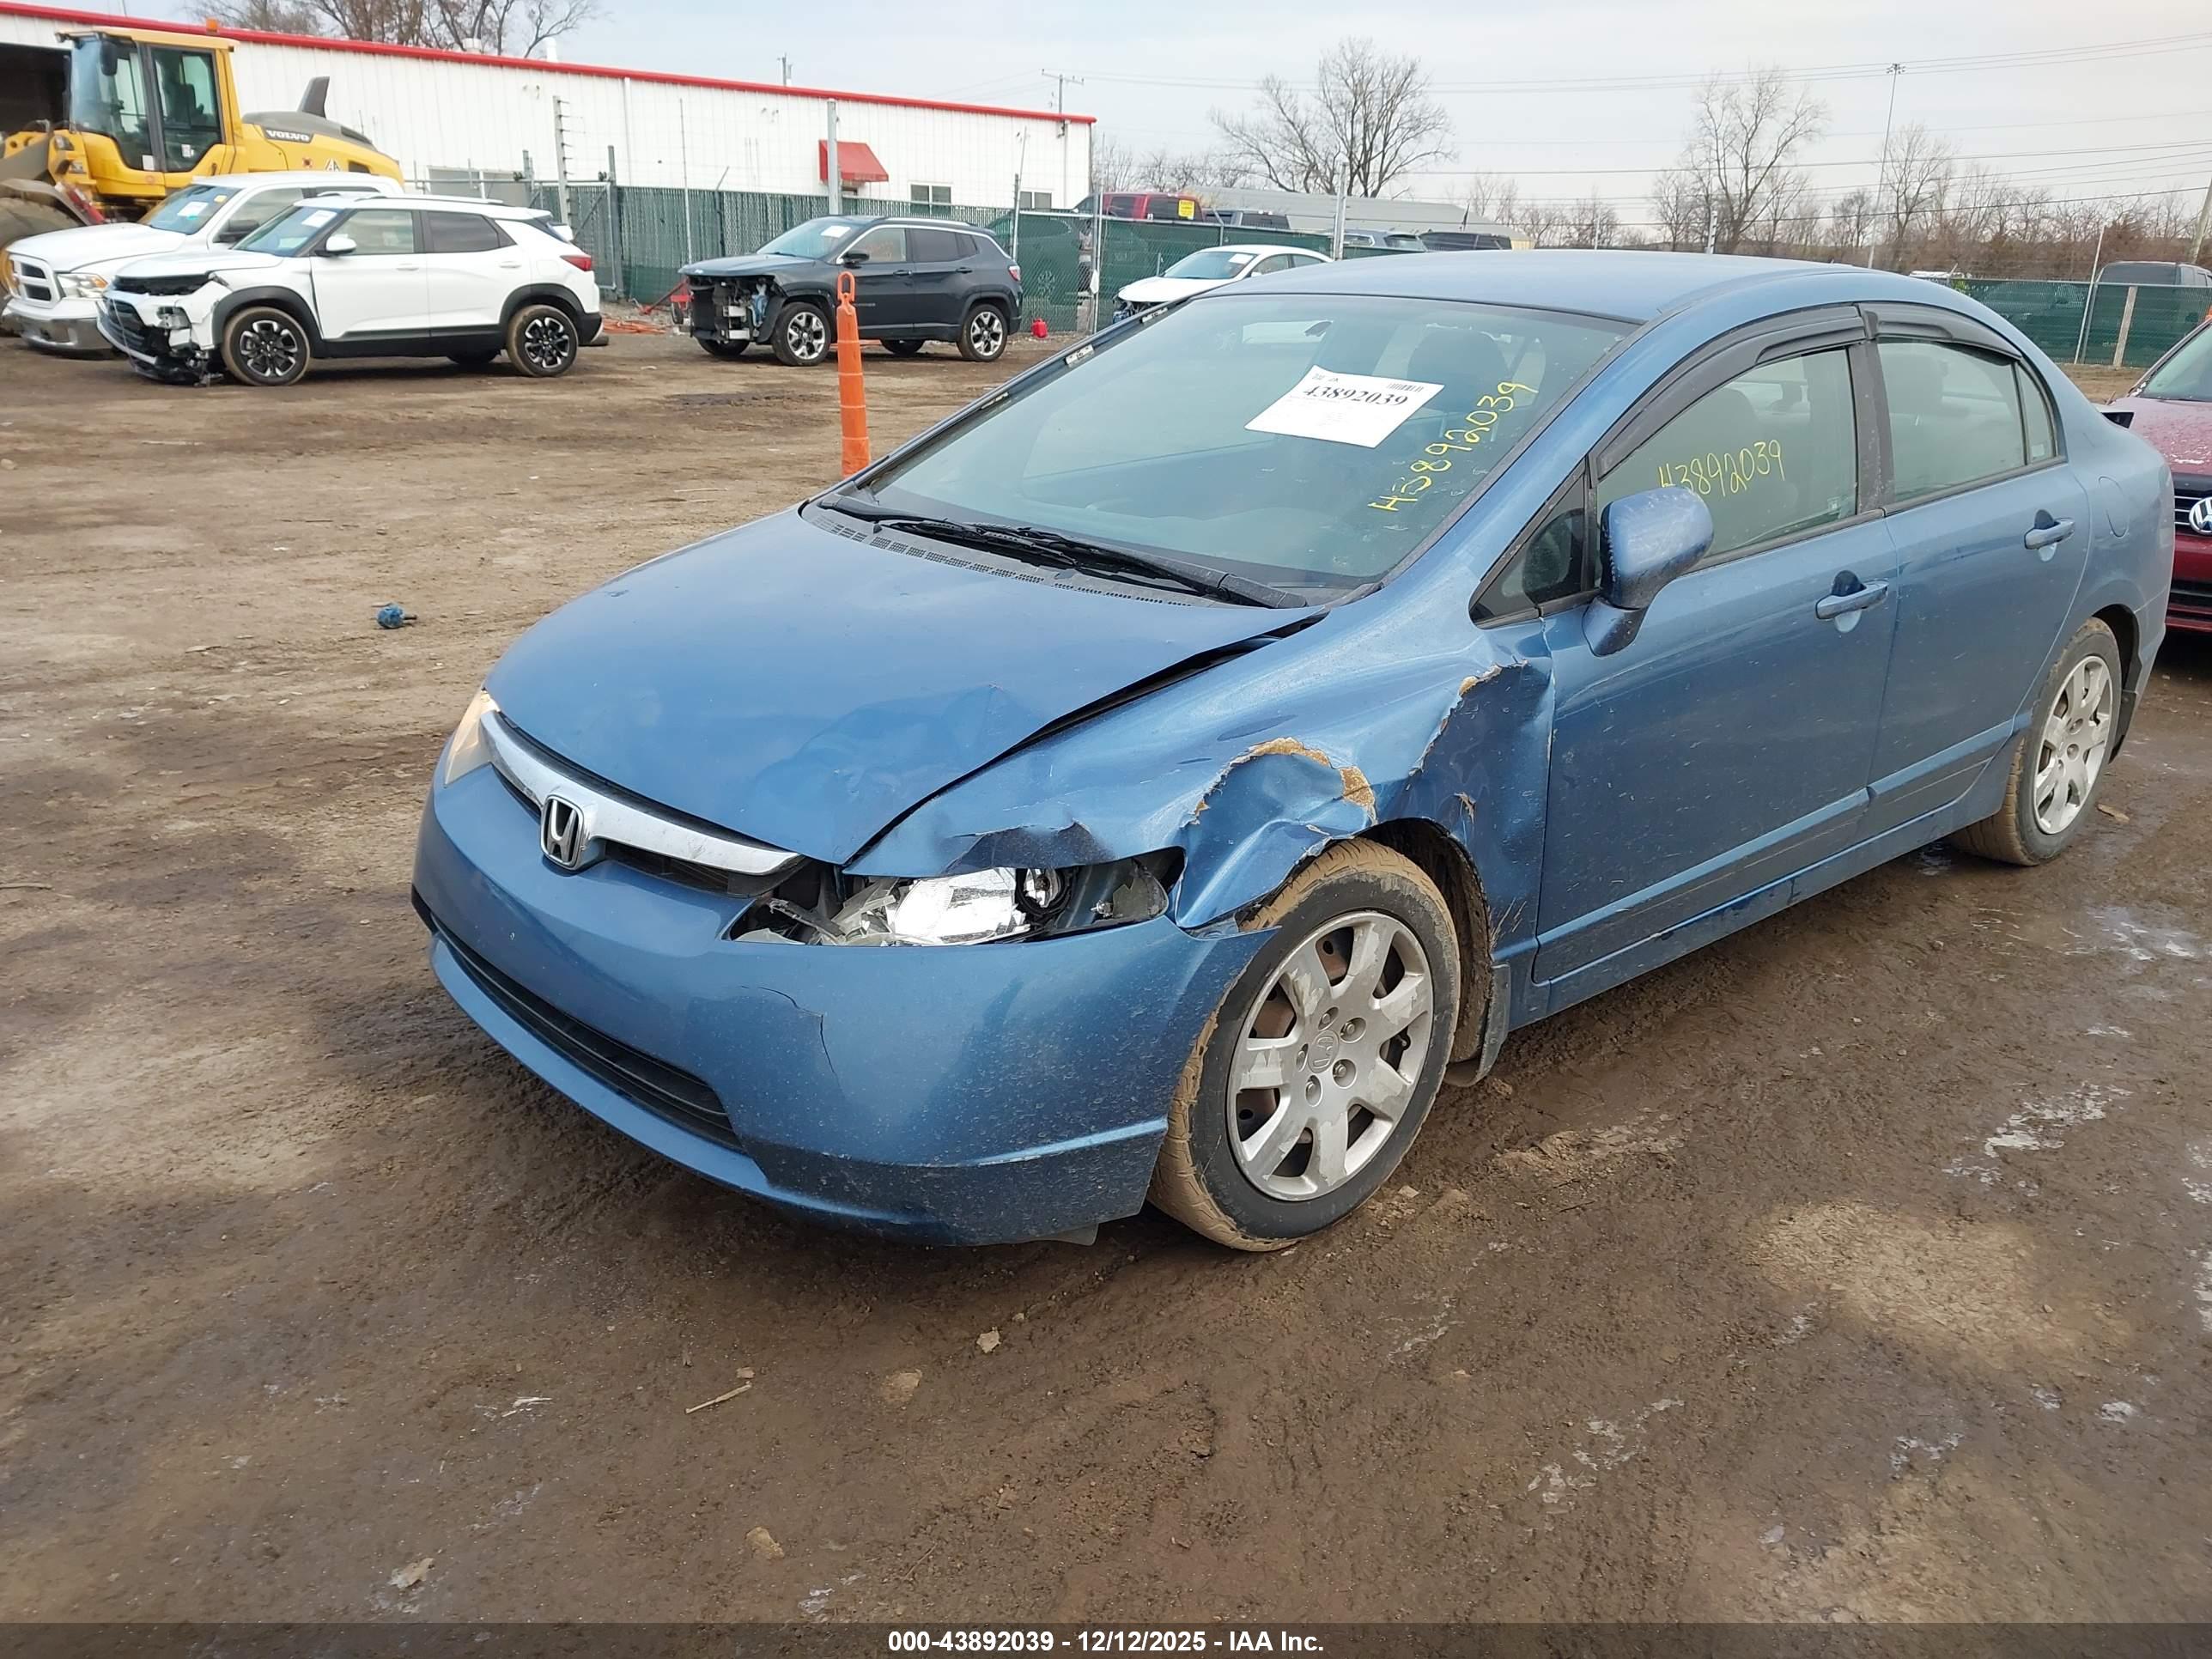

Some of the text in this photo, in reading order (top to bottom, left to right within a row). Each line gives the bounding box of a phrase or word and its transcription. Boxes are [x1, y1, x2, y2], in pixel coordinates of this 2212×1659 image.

[266, 130, 310, 142] VOLVO
[1303, 385, 1409, 406] 43892039
[1367, 381, 1539, 512] 43892039
[1658, 439, 1785, 497] 43892039
